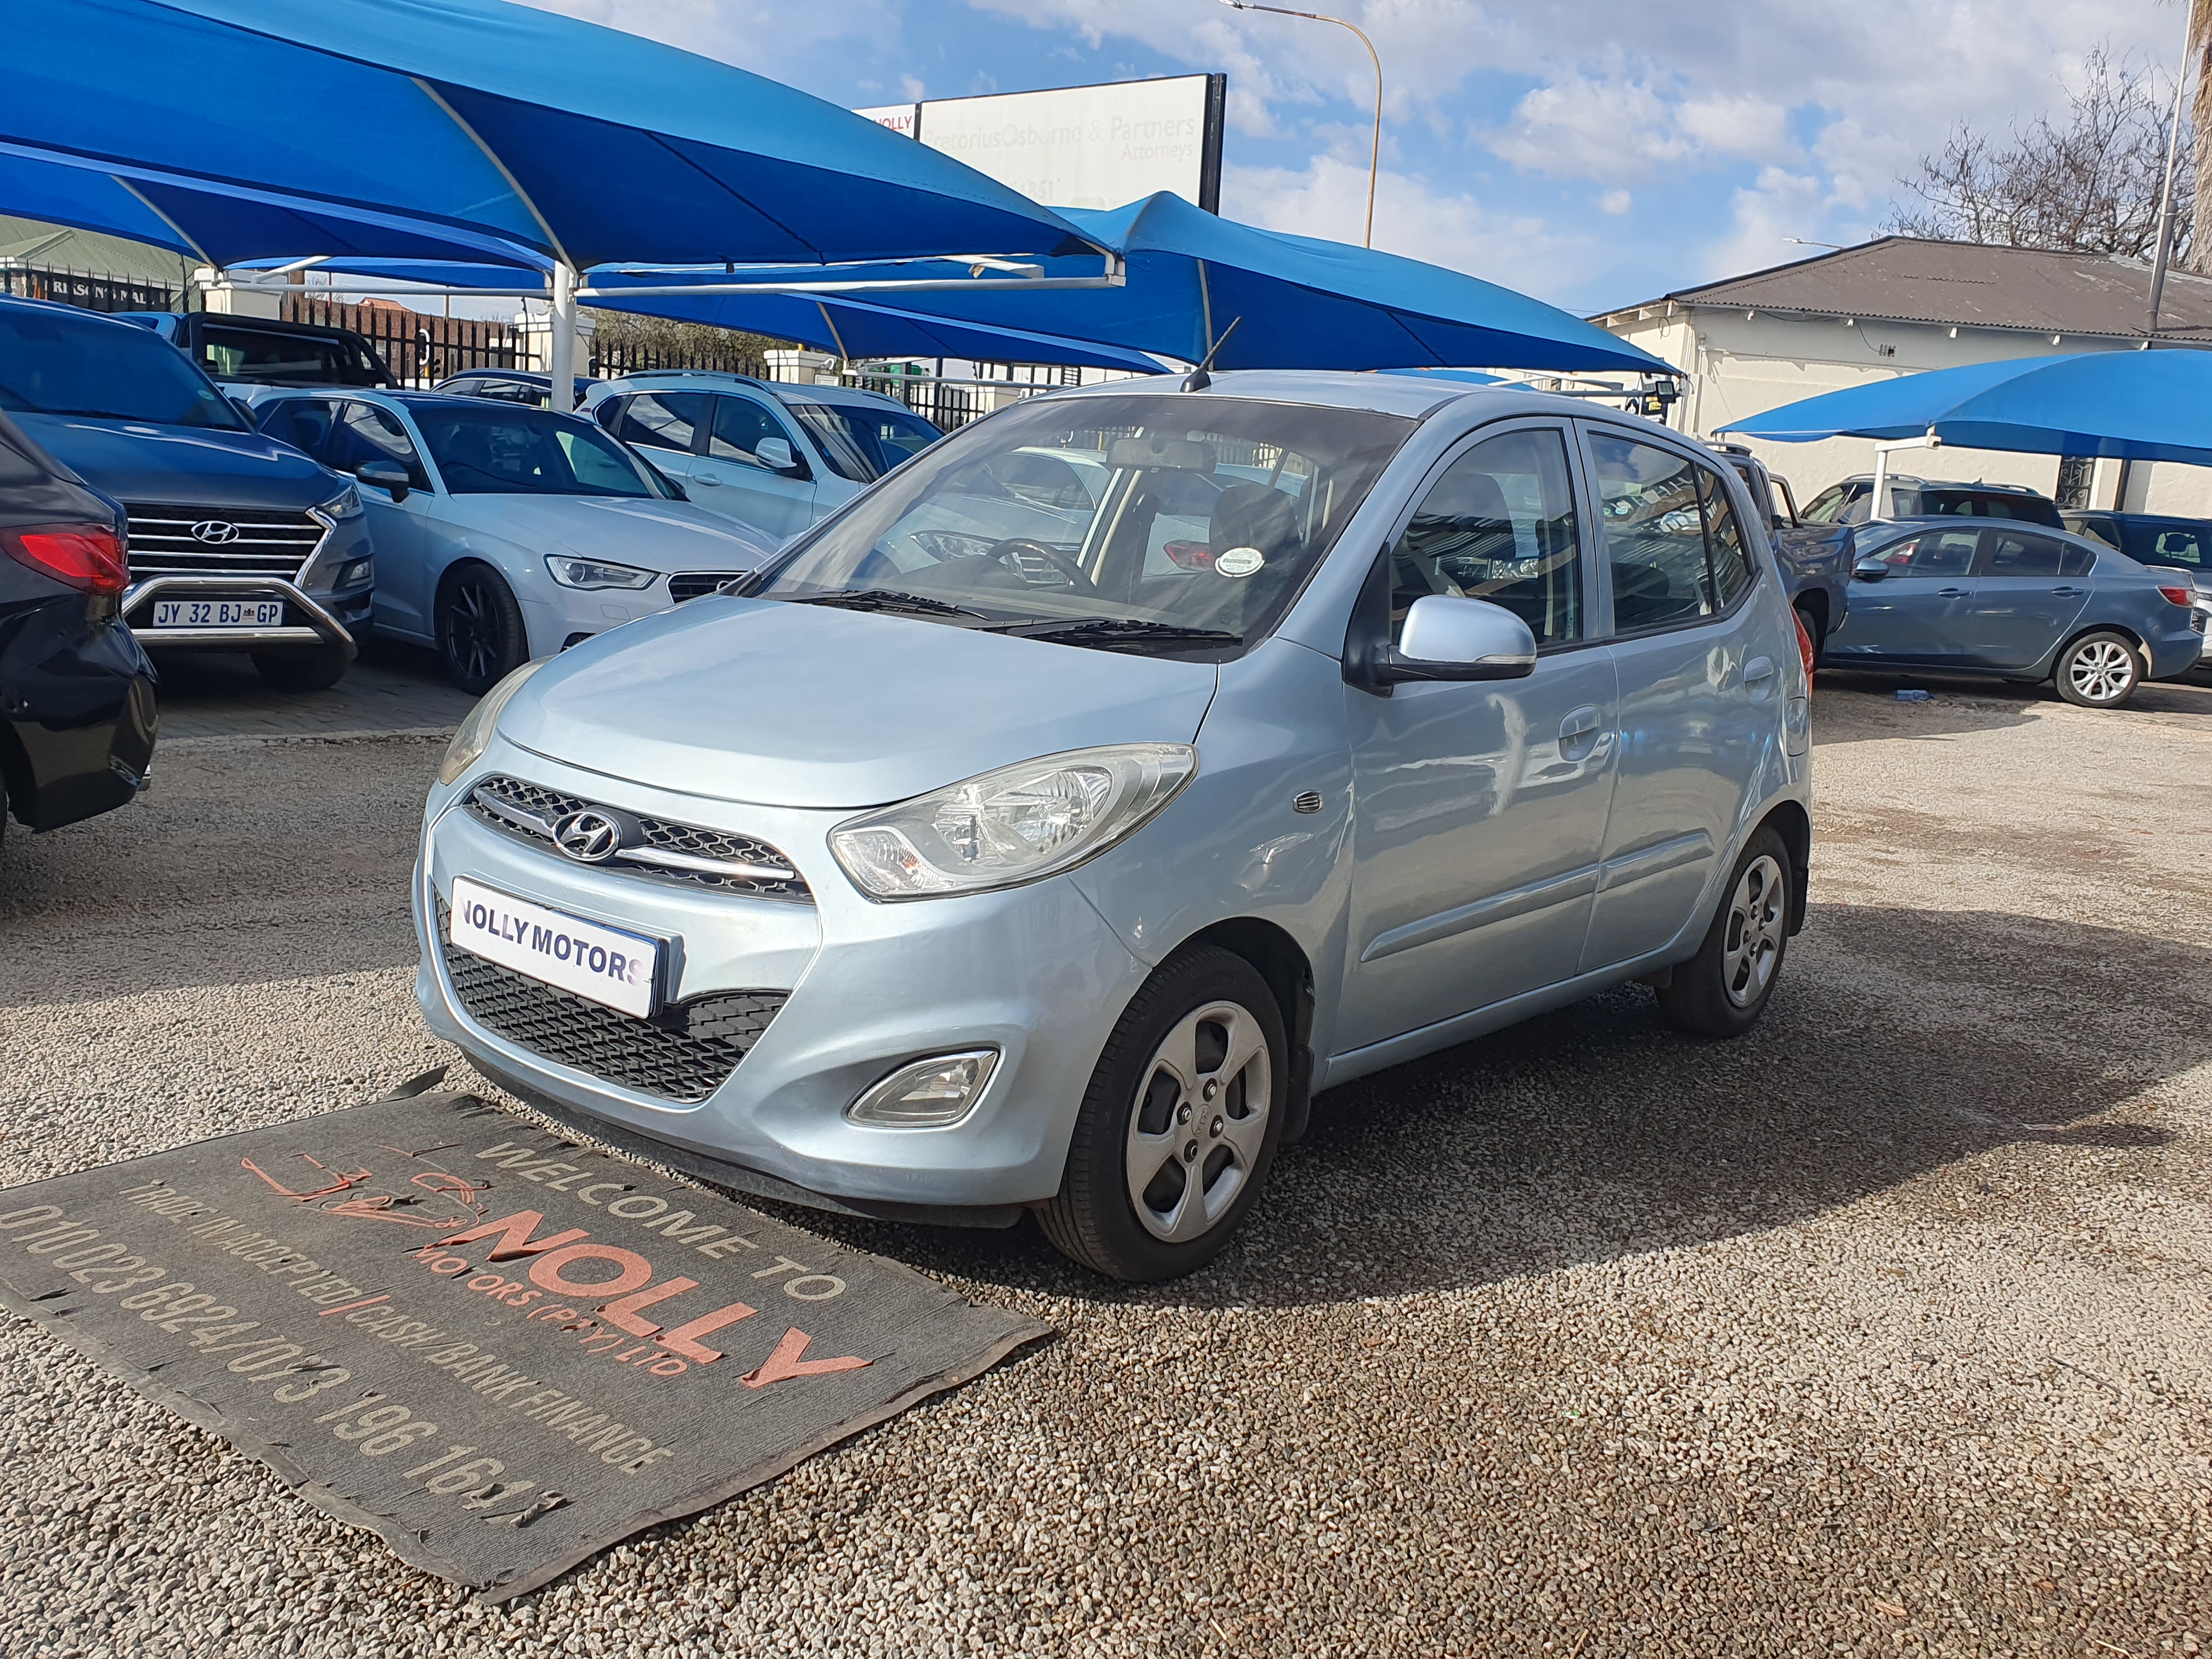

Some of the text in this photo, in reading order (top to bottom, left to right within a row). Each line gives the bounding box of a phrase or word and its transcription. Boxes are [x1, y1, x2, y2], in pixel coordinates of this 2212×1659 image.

[1088, 118, 1103, 142] &
[1110, 116, 1195, 141] Partners
[1121, 143, 1193, 162] Attorneys
[120, 290, 156, 305] MAL
[159, 603, 278, 623] JY 32 BJ GP
[532, 924, 644, 986] MOTORS
[1194, 1107, 1210, 1135] KIA
[475, 1142, 847, 1300] WELCOME TO
[425, 1209, 873, 1389] NOLLY
[119, 1179, 219, 1224] TRADE
[186, 1216, 246, 1239] IN
[510, 1388, 675, 1475] FINANCE
[614, 1345, 688, 1375] LTD
[314, 1391, 438, 1457] 196
